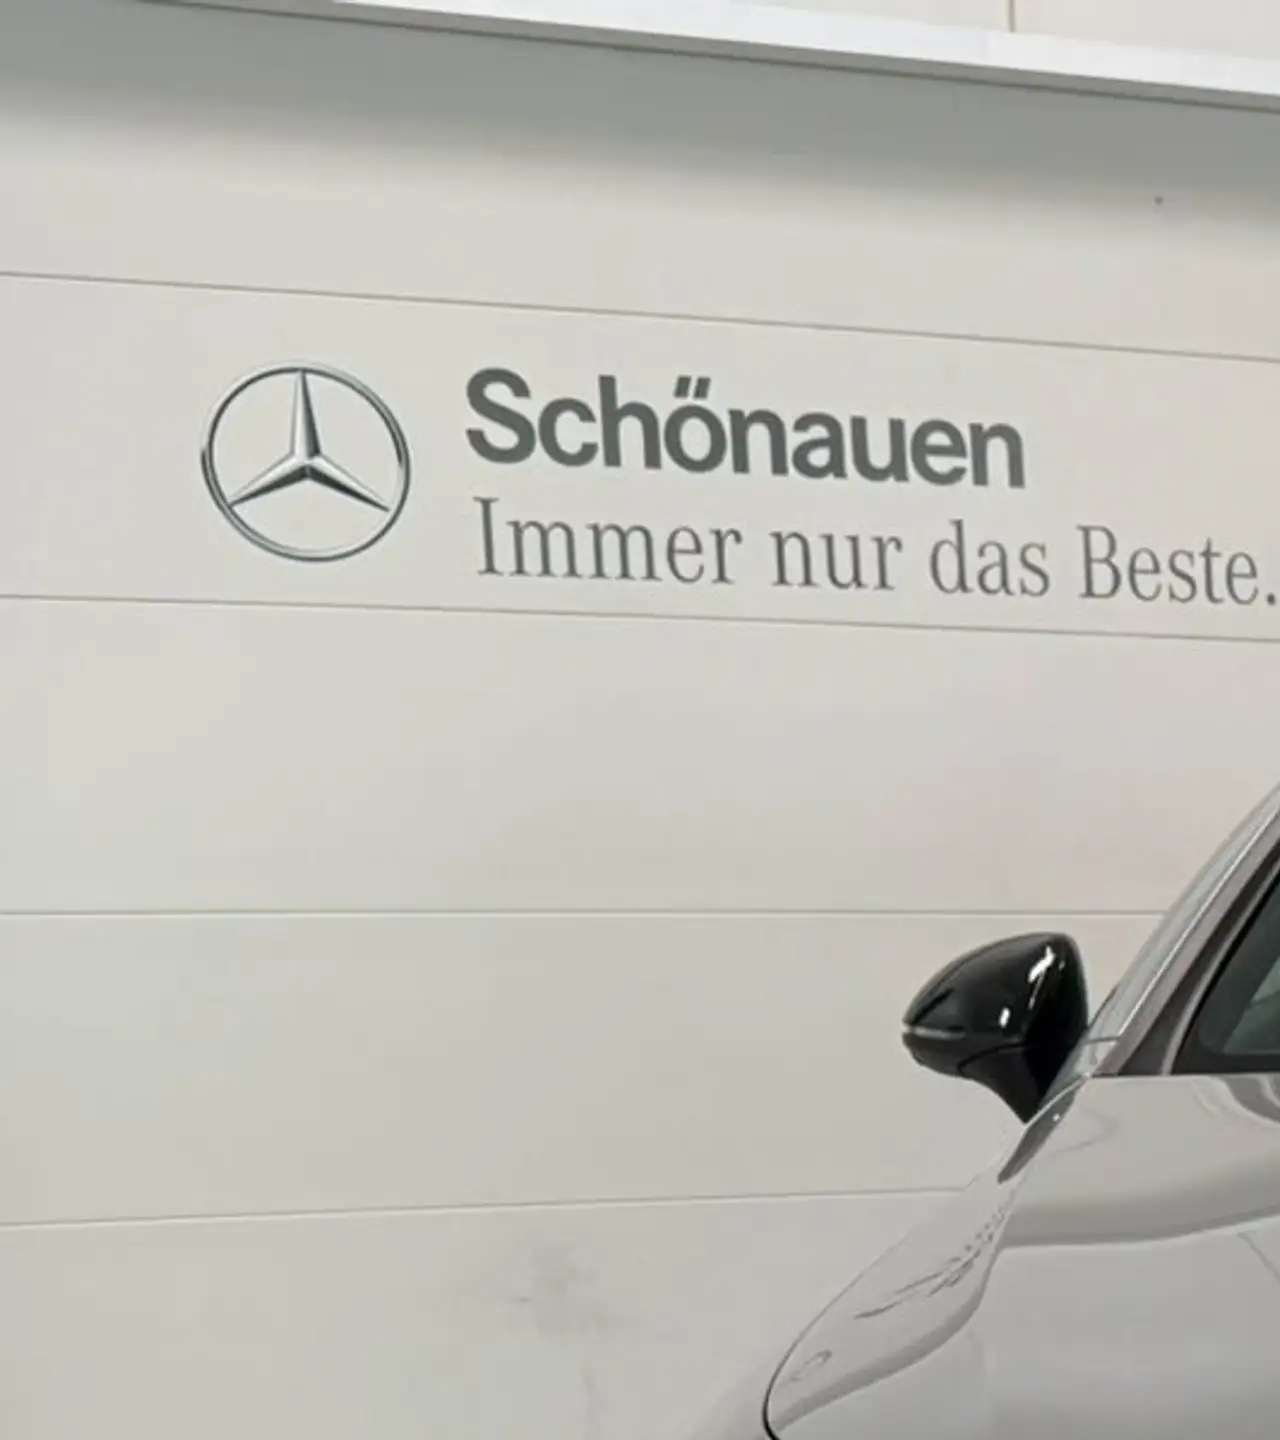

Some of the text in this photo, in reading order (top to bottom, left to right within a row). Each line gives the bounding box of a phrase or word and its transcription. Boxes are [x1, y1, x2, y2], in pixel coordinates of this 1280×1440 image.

[464, 366, 1026, 490] Schönauen
[472, 495, 1278, 607] Immer nur das Beste.
